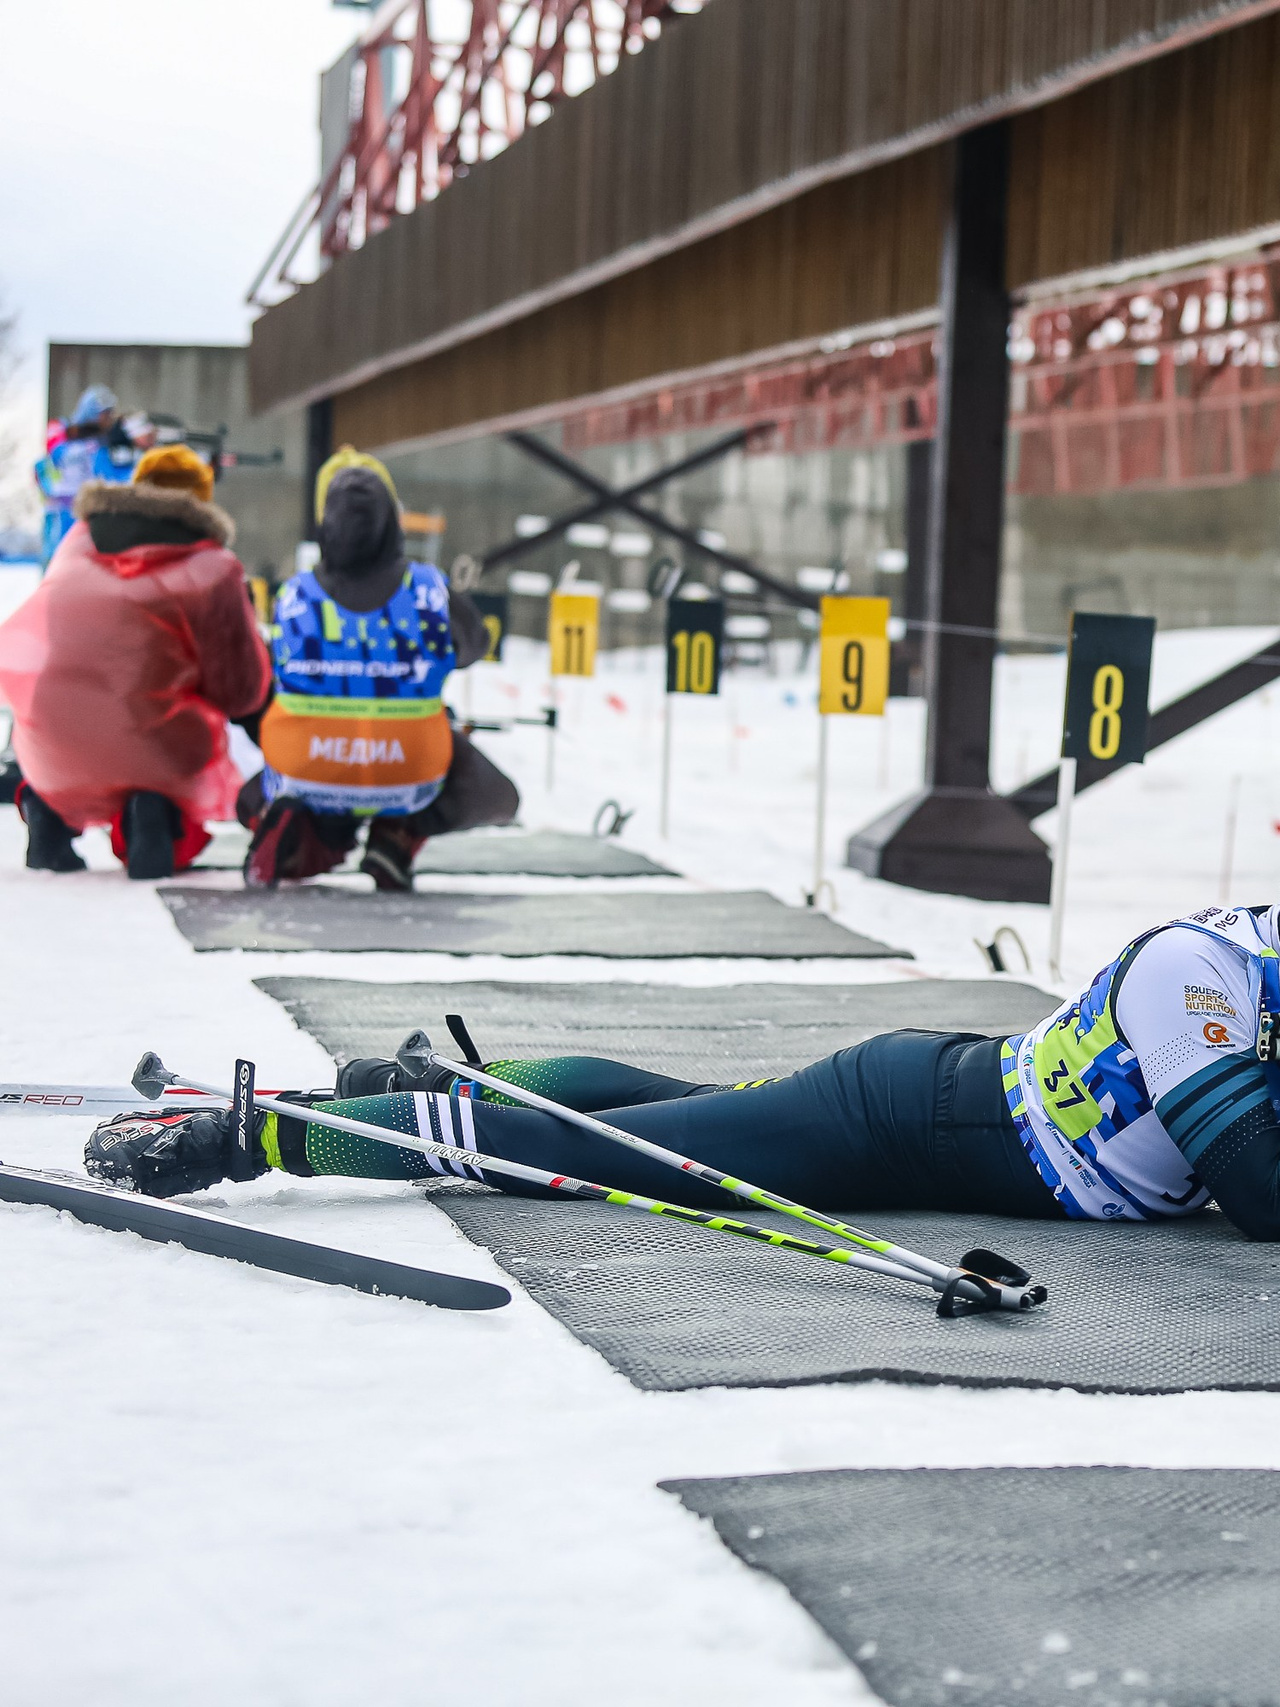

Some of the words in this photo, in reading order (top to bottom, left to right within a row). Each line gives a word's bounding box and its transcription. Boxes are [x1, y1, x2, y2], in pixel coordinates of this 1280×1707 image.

[563, 626, 585, 673] 11
[673, 631, 714, 693] 10
[842, 641, 864, 712] 9
[1089, 664, 1124, 760] 8
[309, 735, 405, 767] МЕДИА
[1185, 1002, 1237, 1017] NUTRITION
[23, 1094, 84, 1106] RED
[1043, 1059, 1087, 1109] 37
[238, 1084, 249, 1151] SPINE
[428, 1143, 488, 1165] AVANTI
